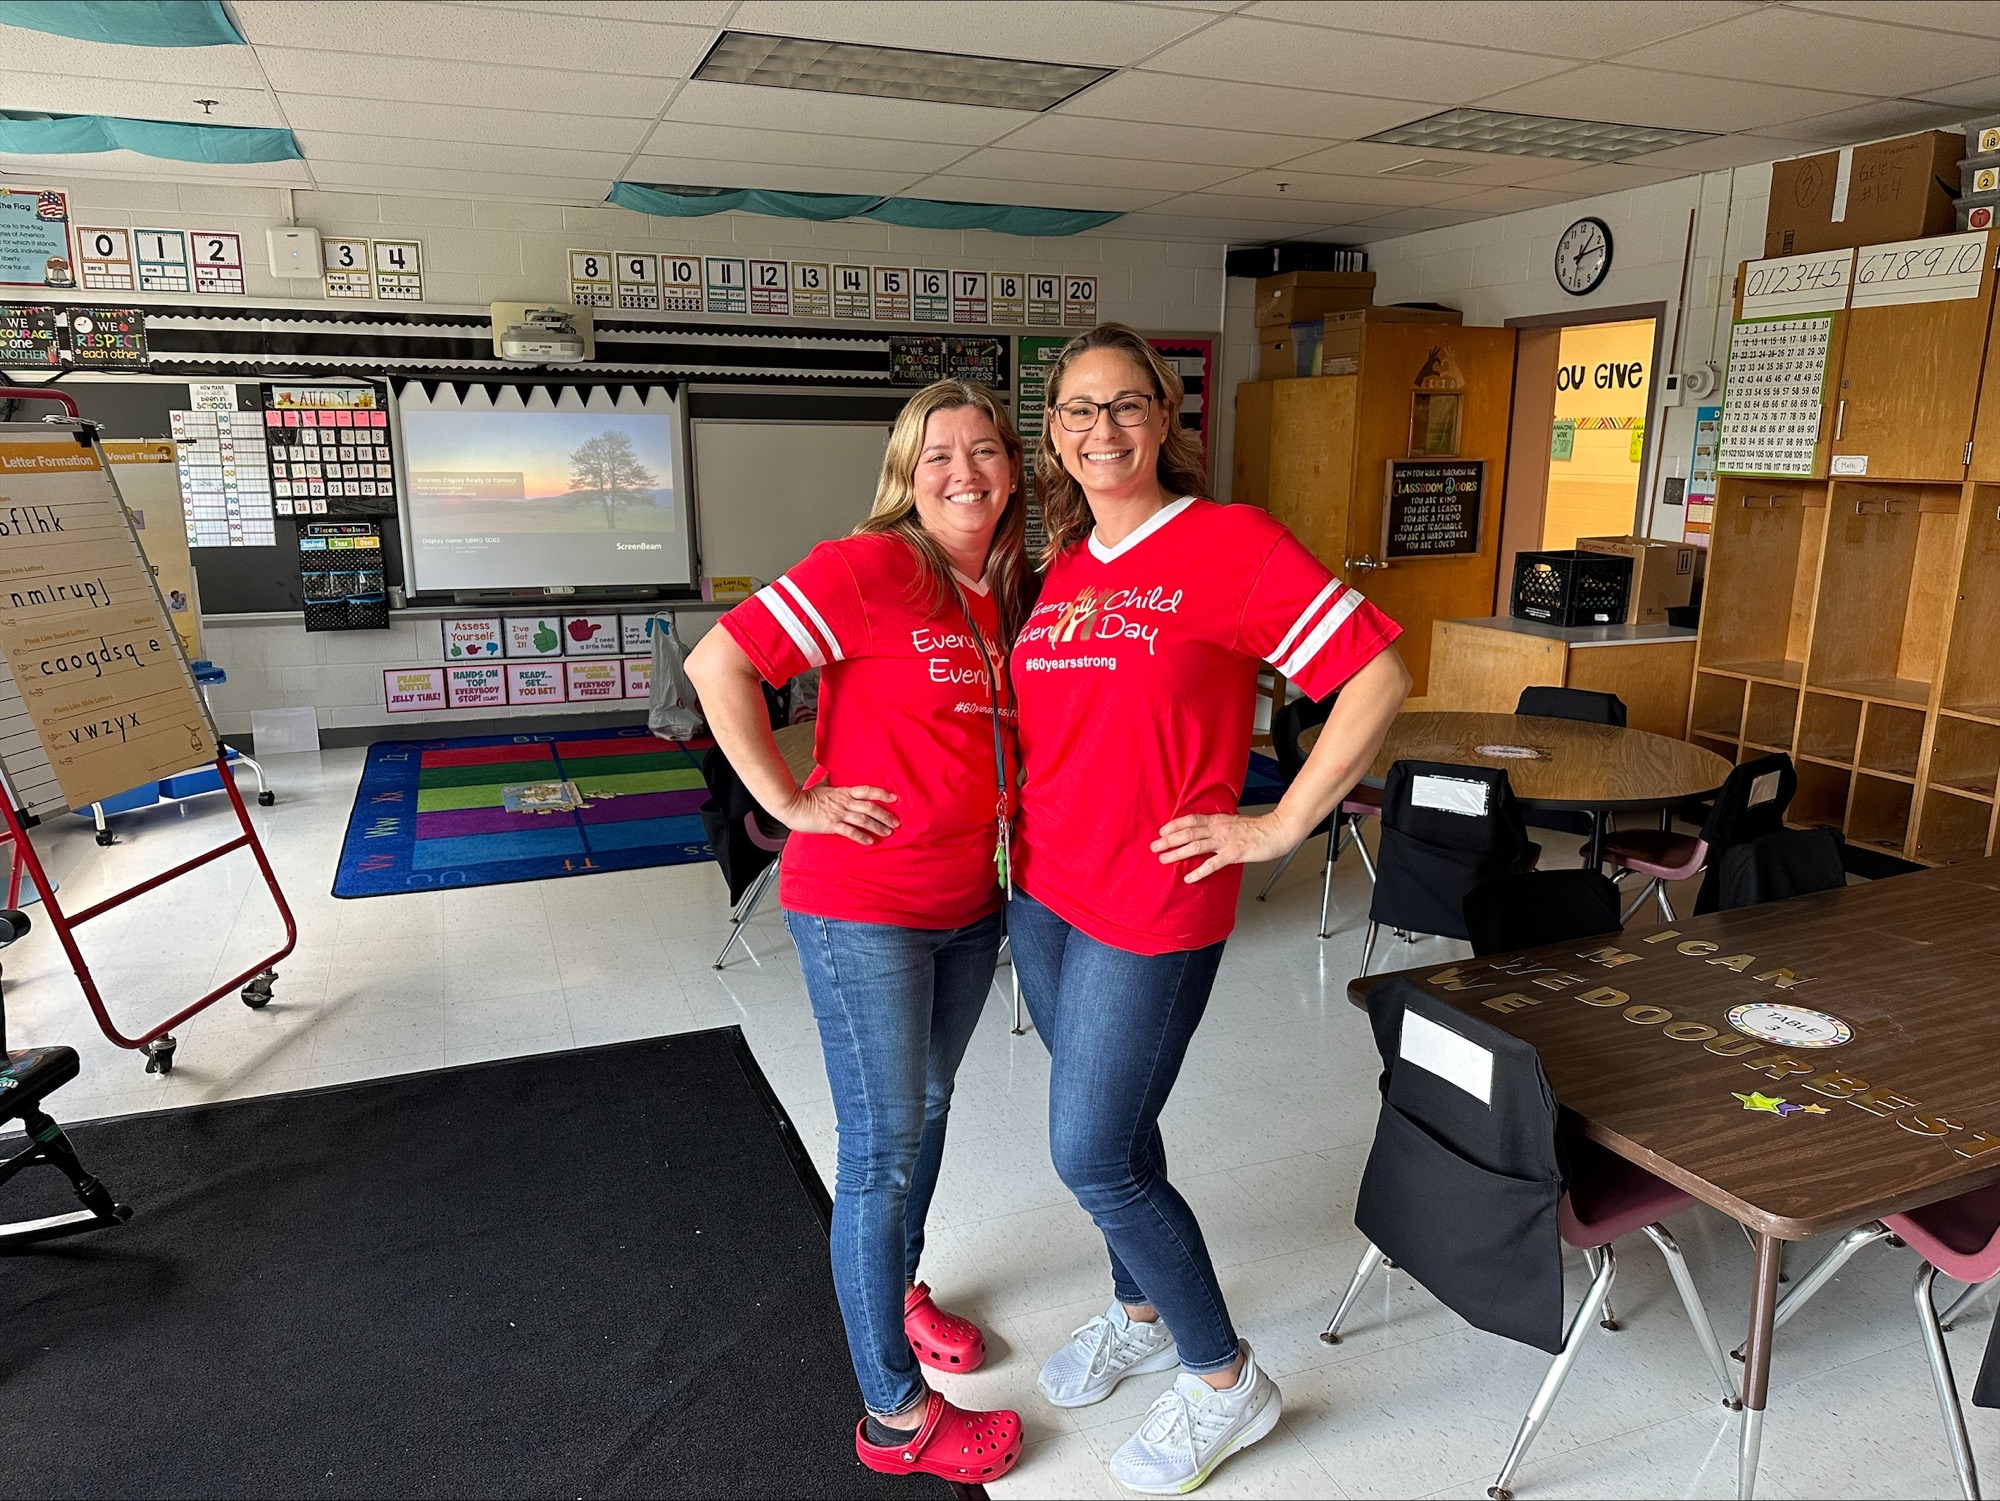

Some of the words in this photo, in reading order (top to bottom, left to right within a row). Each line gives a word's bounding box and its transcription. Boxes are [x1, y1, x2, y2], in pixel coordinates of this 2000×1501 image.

[1986, 137, 1996, 147] 18
[1983, 178, 1989, 187] 2
[13, 203, 31, 212] Flag
[1580, 224, 1587, 234] 12
[95, 234, 113, 257] 0
[157, 236, 165, 259] 1
[208, 239, 225, 261] 2
[338, 245, 354, 267] 3
[388, 247, 406, 269] 4
[584, 257, 599, 278] 8
[630, 259, 645, 280] 9
[672, 261, 692, 282] 10
[721, 264, 731, 284] 11
[760, 266, 778, 286] 12
[802, 267, 820, 288] 13
[843, 271, 861, 291] 14
[884, 272, 901, 293] 15
[923, 274, 940, 294] 16
[963, 276, 978, 296] 17
[1001, 278, 1016, 297] 18
[1036, 279, 1053, 299] 19
[1070, 281, 1092, 300] 20
[6, 318, 28, 328] WE
[97, 321, 118, 332] WE
[9, 339, 33, 349] one
[76, 334, 143, 348] RESPECT
[82, 349, 108, 359] each
[110, 349, 140, 359] other
[910, 347, 924, 355] WE
[965, 348, 979, 356] WE
[899, 370, 934, 379] FORGIVE
[299, 390, 351, 407] AUGUST
[172, 414, 181, 422] 10
[1, 456, 36, 468] Letter
[38, 455, 94, 467] Formation
[106, 452, 136, 461] Vowel
[137, 452, 169, 460] Teams
[443, 477, 465, 485] Display
[313, 485, 321, 494] 22
[331, 484, 339, 493] 23
[364, 484, 372, 493] 25
[381, 485, 390, 494] 26
[1392, 479, 1443, 497] CLASSROOM
[1445, 476, 1478, 495] DOORS
[1439, 495, 1457, 503] KIND
[313, 526, 339, 534] Place
[616, 542, 662, 550] ScreenBeam
[1030, 601, 1069, 619] Every
[1104, 585, 1183, 614] Child
[454, 622, 490, 631] Assess
[512, 625, 529, 633] I've
[450, 632, 495, 642] Yourself
[514, 633, 528, 641] Got
[1014, 624, 1061, 651] Every
[1095, 613, 1158, 655] Day
[517, 641, 527, 649] It!
[911, 628, 981, 661] Every
[1025, 655, 1117, 673] #60yearsstrong
[397, 673, 431, 684] PEANUT
[453, 670, 484, 680] HANDS
[485, 669, 498, 678] ON
[928, 657, 989, 698] Every
[398, 682, 432, 692] BUTTER
[466, 678, 487, 688] TOP!
[573, 681, 615, 689] EVERYBODY
[455, 686, 500, 696] EVERYBODY
[518, 687, 538, 696] YOU
[538, 687, 556, 695] BET!
[580, 688, 610, 696] FREEZE!
[391, 694, 415, 704] JELLY
[417, 692, 441, 702] TIME!
[457, 694, 481, 703] STOP!
[1764, 1025, 1781, 1033] 3
[1766, 1012, 1825, 1036] TABLE
